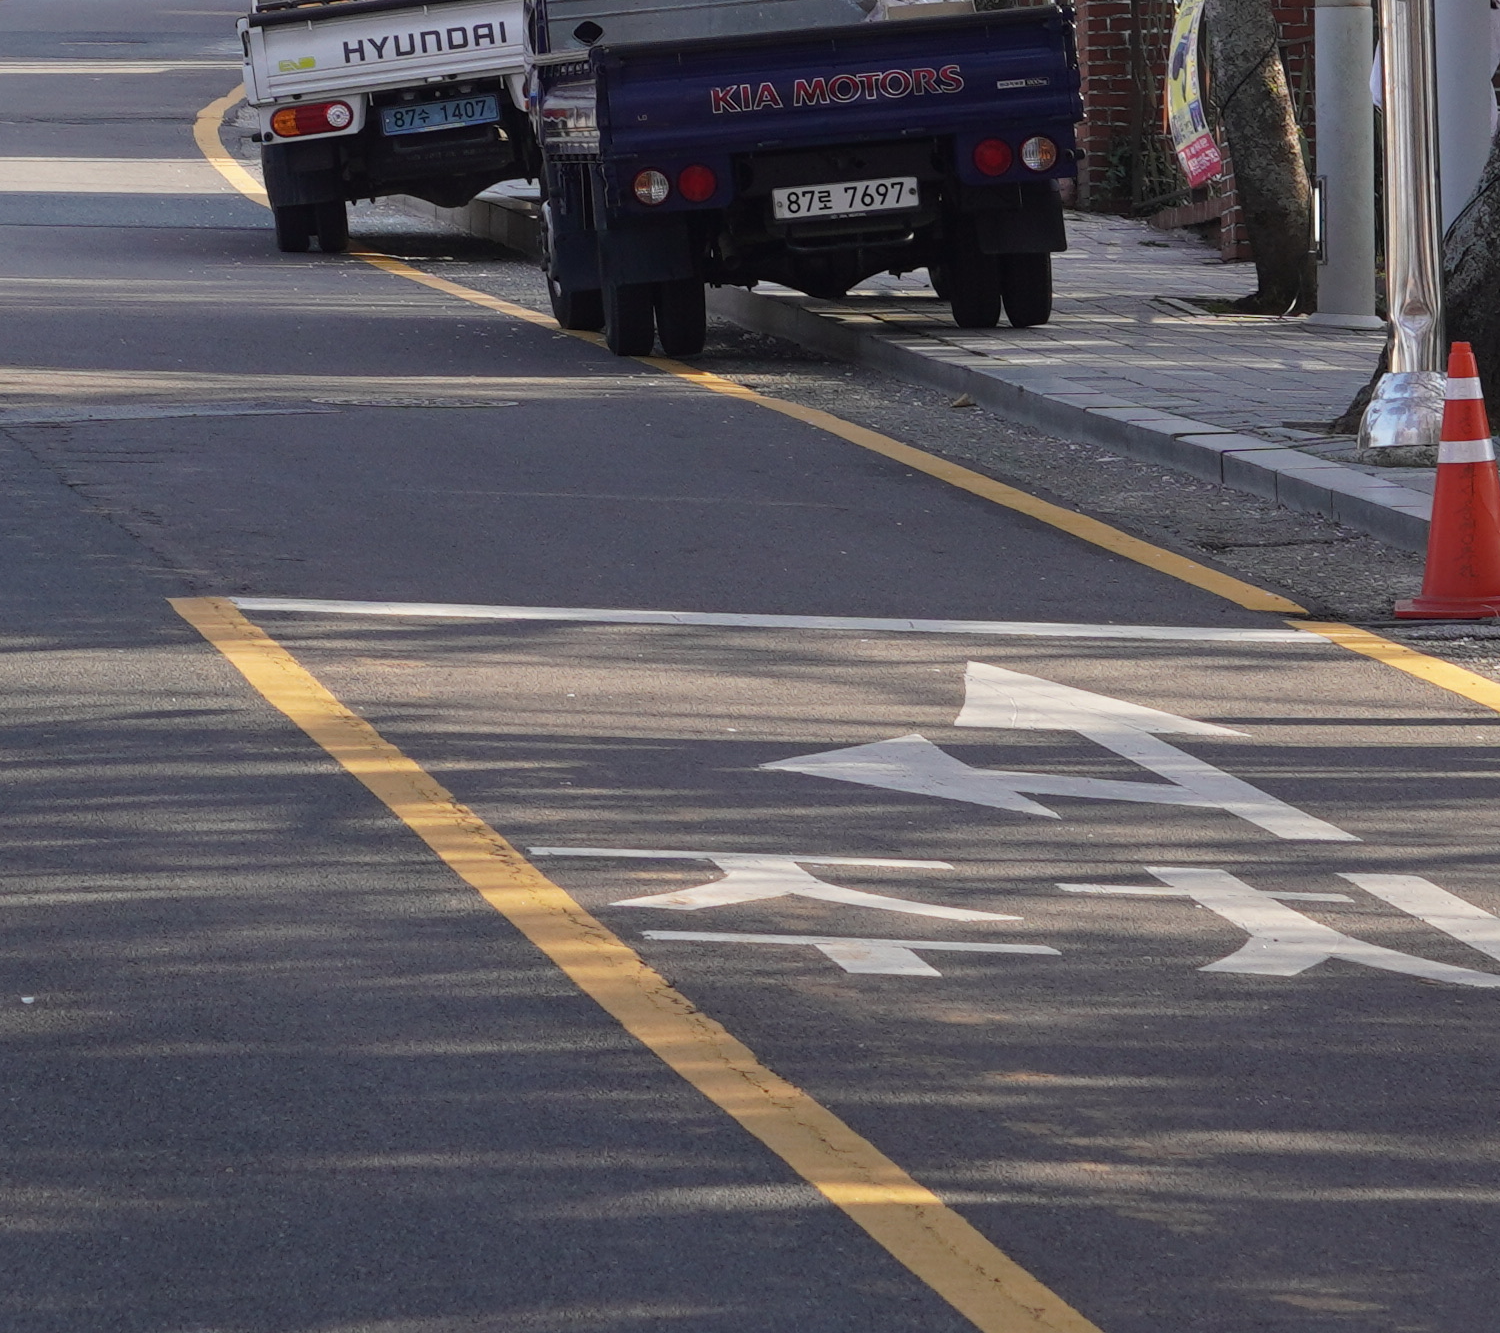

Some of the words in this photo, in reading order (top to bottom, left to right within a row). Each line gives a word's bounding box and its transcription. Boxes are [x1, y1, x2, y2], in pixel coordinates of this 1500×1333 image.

[342, 20, 508, 64] HYUNDAI
[710, 82, 783, 114] KIA
[793, 64, 965, 108] MOTORS
[393, 109, 431, 129] 87수
[440, 99, 487, 122] 1407
[786, 189, 834, 214] 87로
[843, 181, 906, 210] 7697
